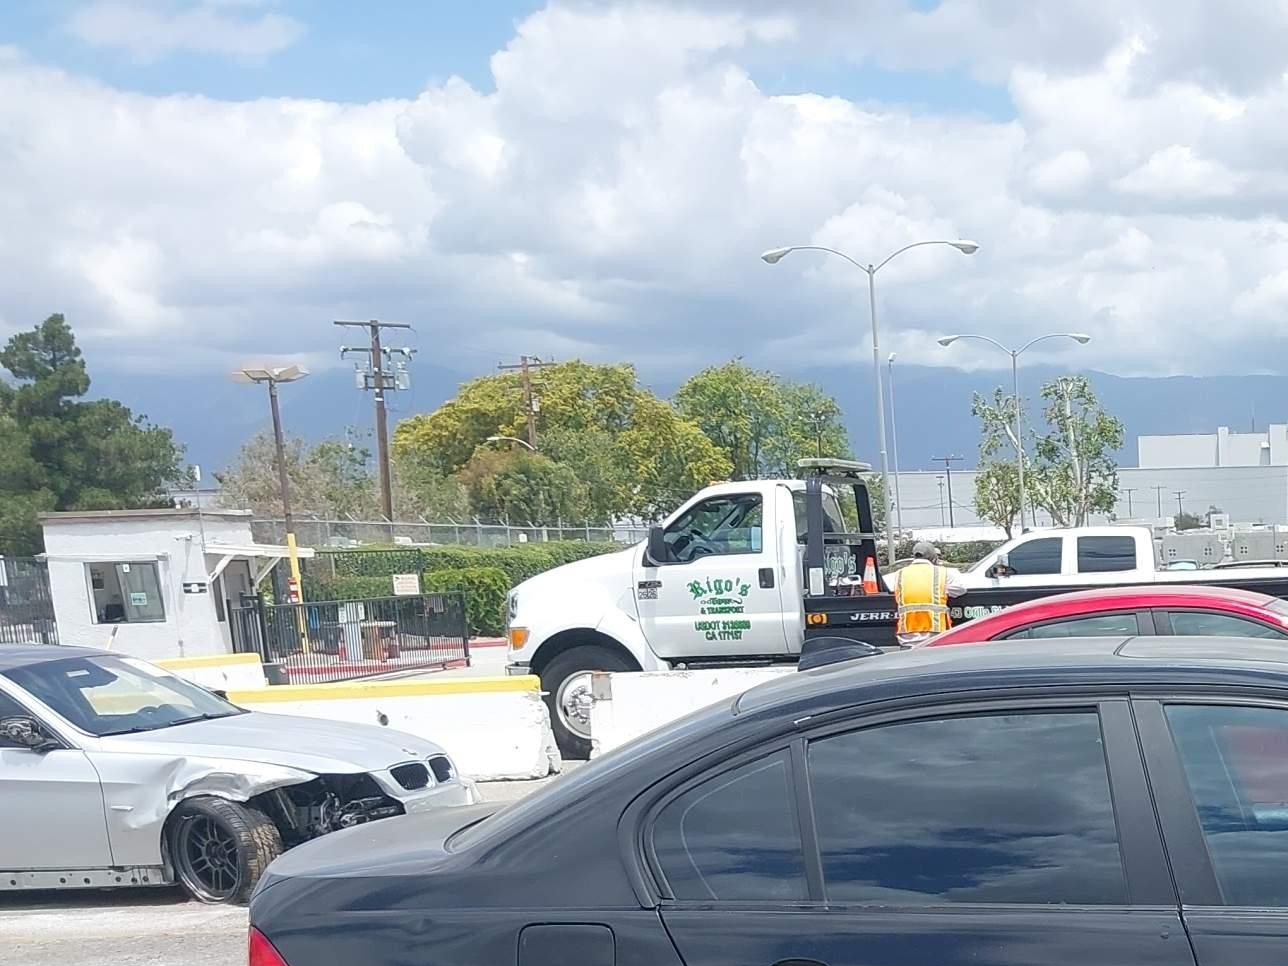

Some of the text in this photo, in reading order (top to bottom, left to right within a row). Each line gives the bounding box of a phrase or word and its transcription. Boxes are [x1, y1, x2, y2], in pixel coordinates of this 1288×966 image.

[687, 576, 751, 600] Rigo's
[707, 606, 744, 614] TRANSPORT
[695, 620, 720, 631] USDOT
[705, 631, 717, 640] CA
